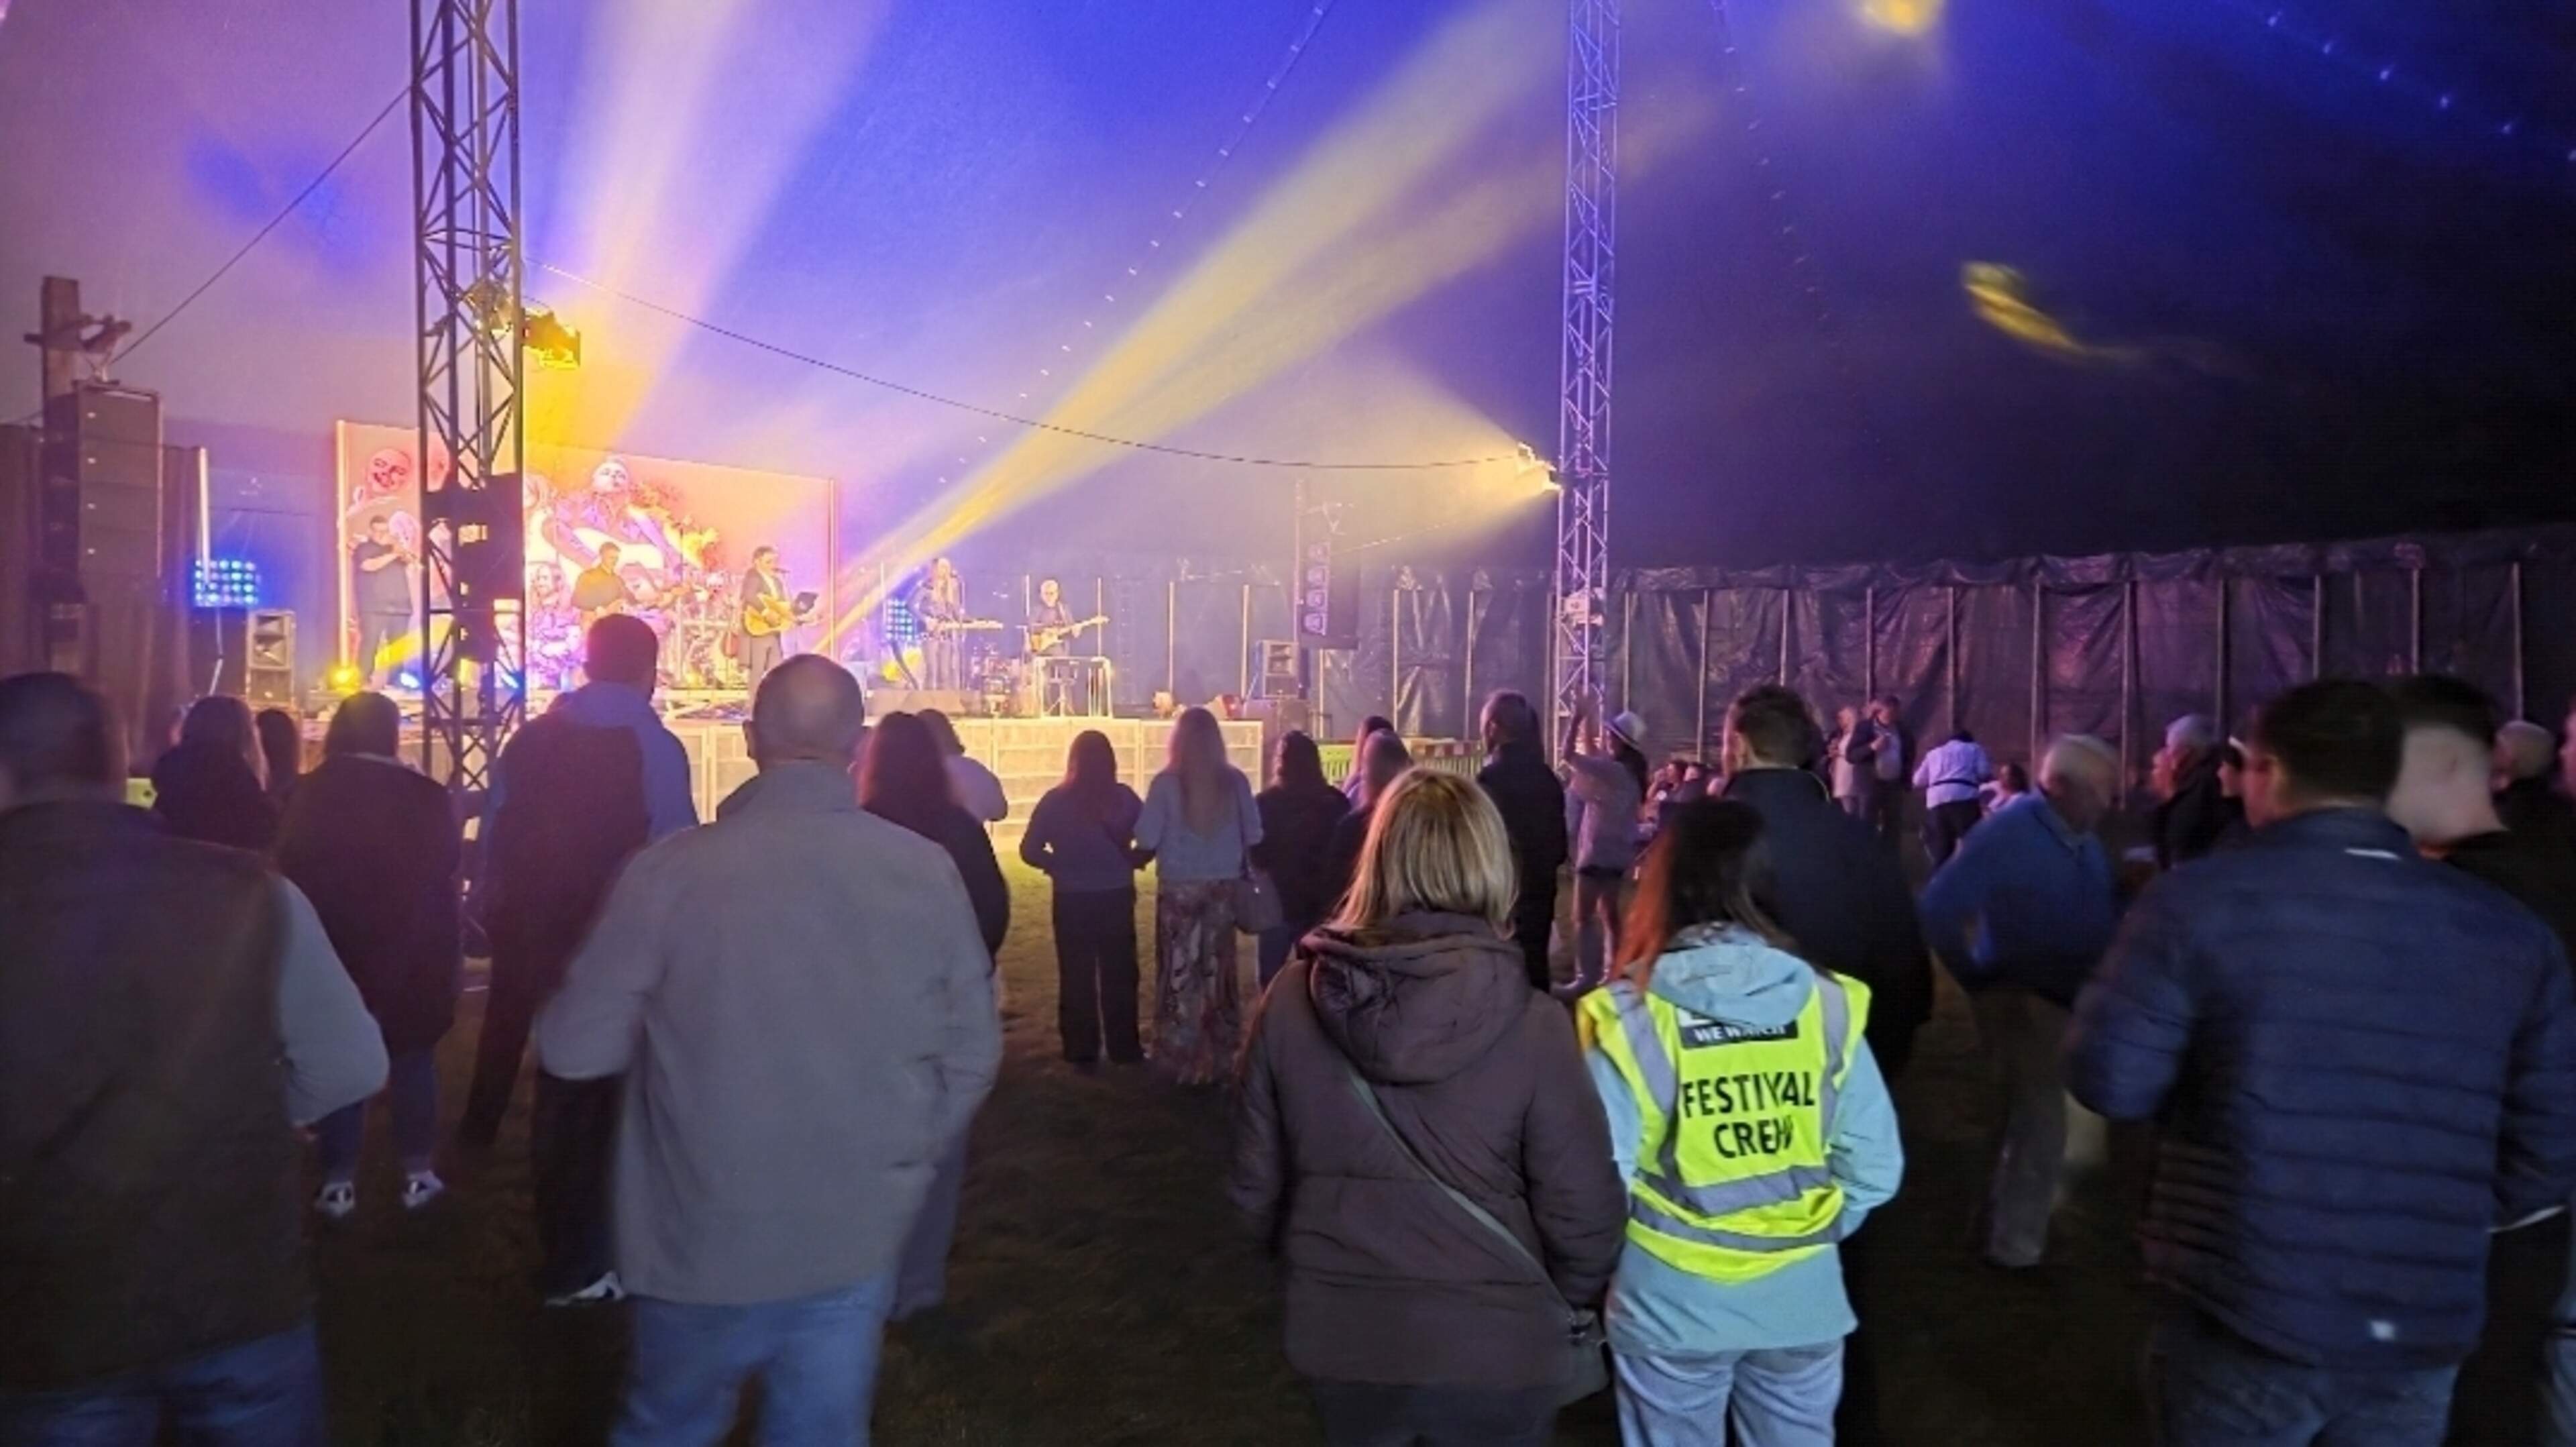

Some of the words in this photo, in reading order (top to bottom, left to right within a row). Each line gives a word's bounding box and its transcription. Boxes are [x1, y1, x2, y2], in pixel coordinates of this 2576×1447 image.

[1693, 1027, 1723, 1042] WE
[1682, 1071, 1815, 1118] FESTIVAL
[1713, 1115, 1794, 1159] CREW
